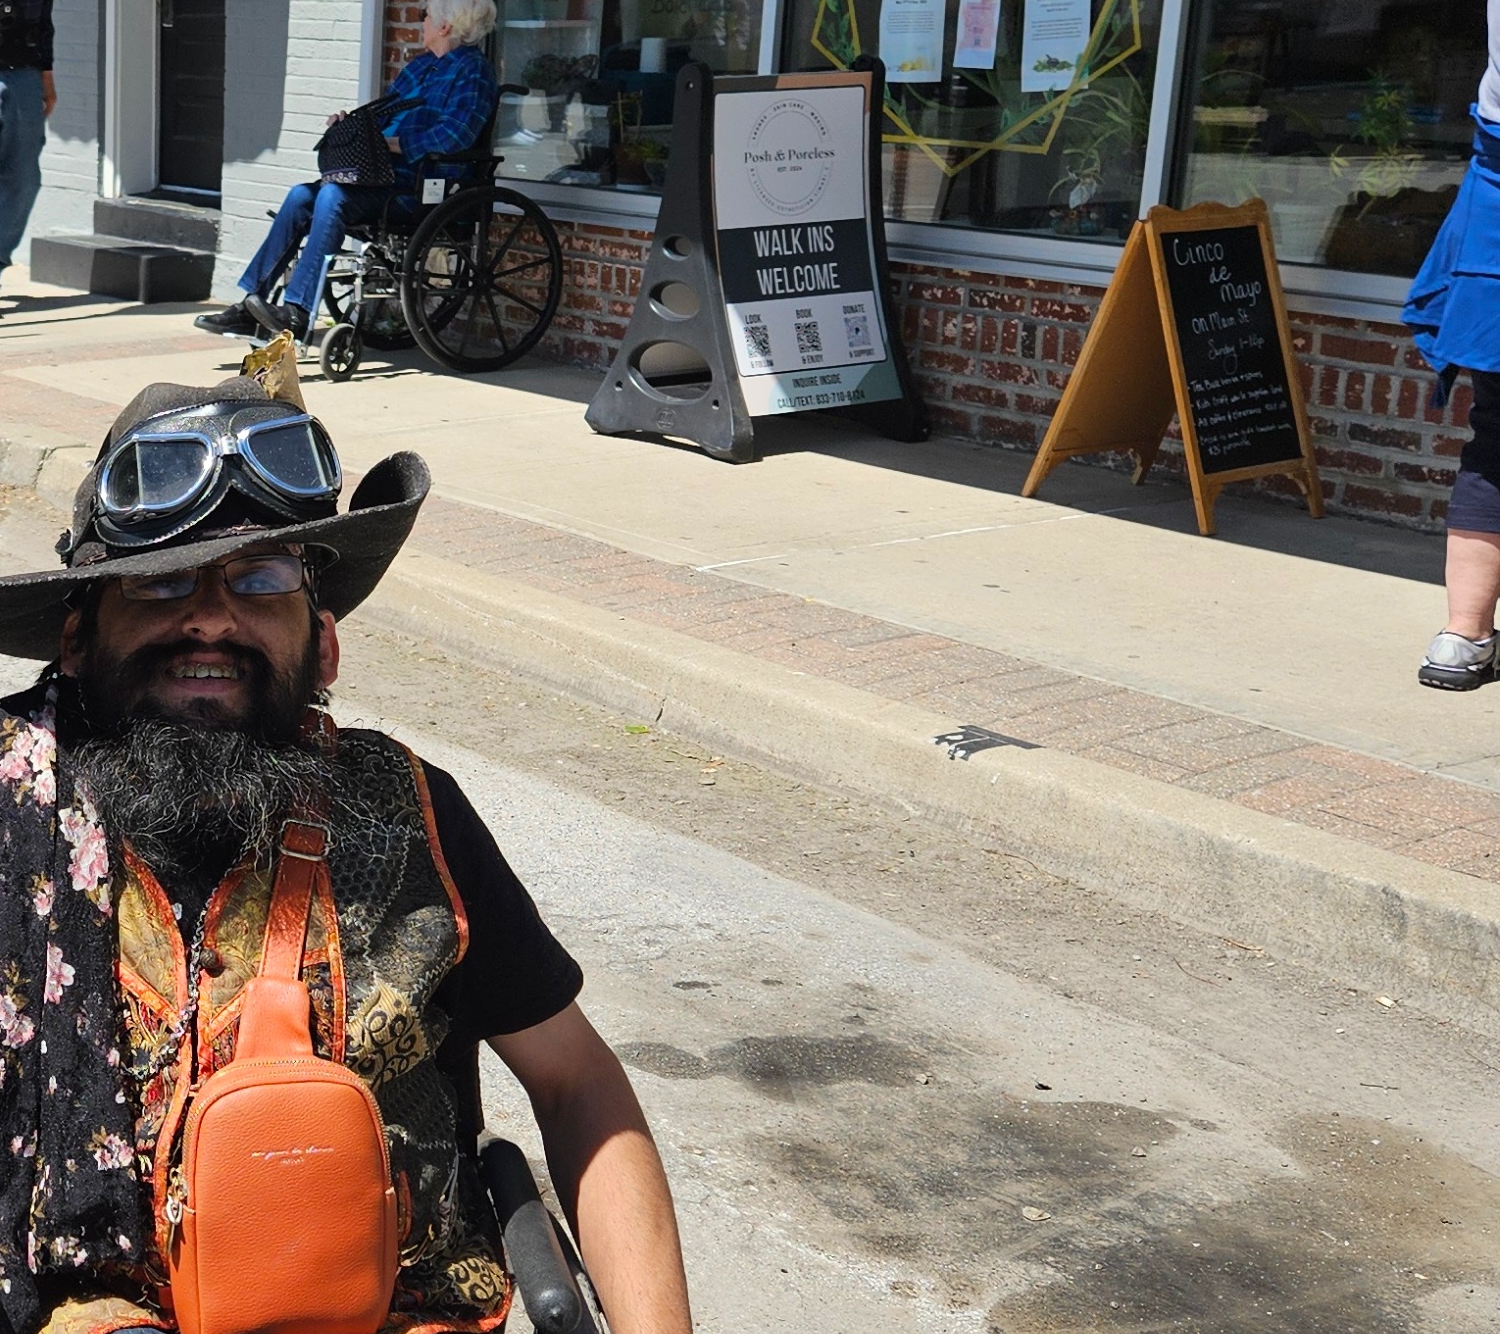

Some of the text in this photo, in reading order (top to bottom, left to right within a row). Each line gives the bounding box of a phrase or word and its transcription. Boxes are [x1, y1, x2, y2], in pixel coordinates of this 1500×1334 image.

[744, 147, 835, 164] Posh & Poreless
[754, 225, 834, 257] WALK INS
[1174, 238, 1224, 265] Cinco
[757, 262, 840, 295] WELCOME
[1209, 266, 1232, 284] de
[1220, 281, 1261, 306] Mayo
[795, 308, 813, 319] BOOK
[842, 304, 865, 314] DONATE
[745, 314, 762, 325] LOOK
[793, 373, 842, 388] INQUIRE INSIDE
